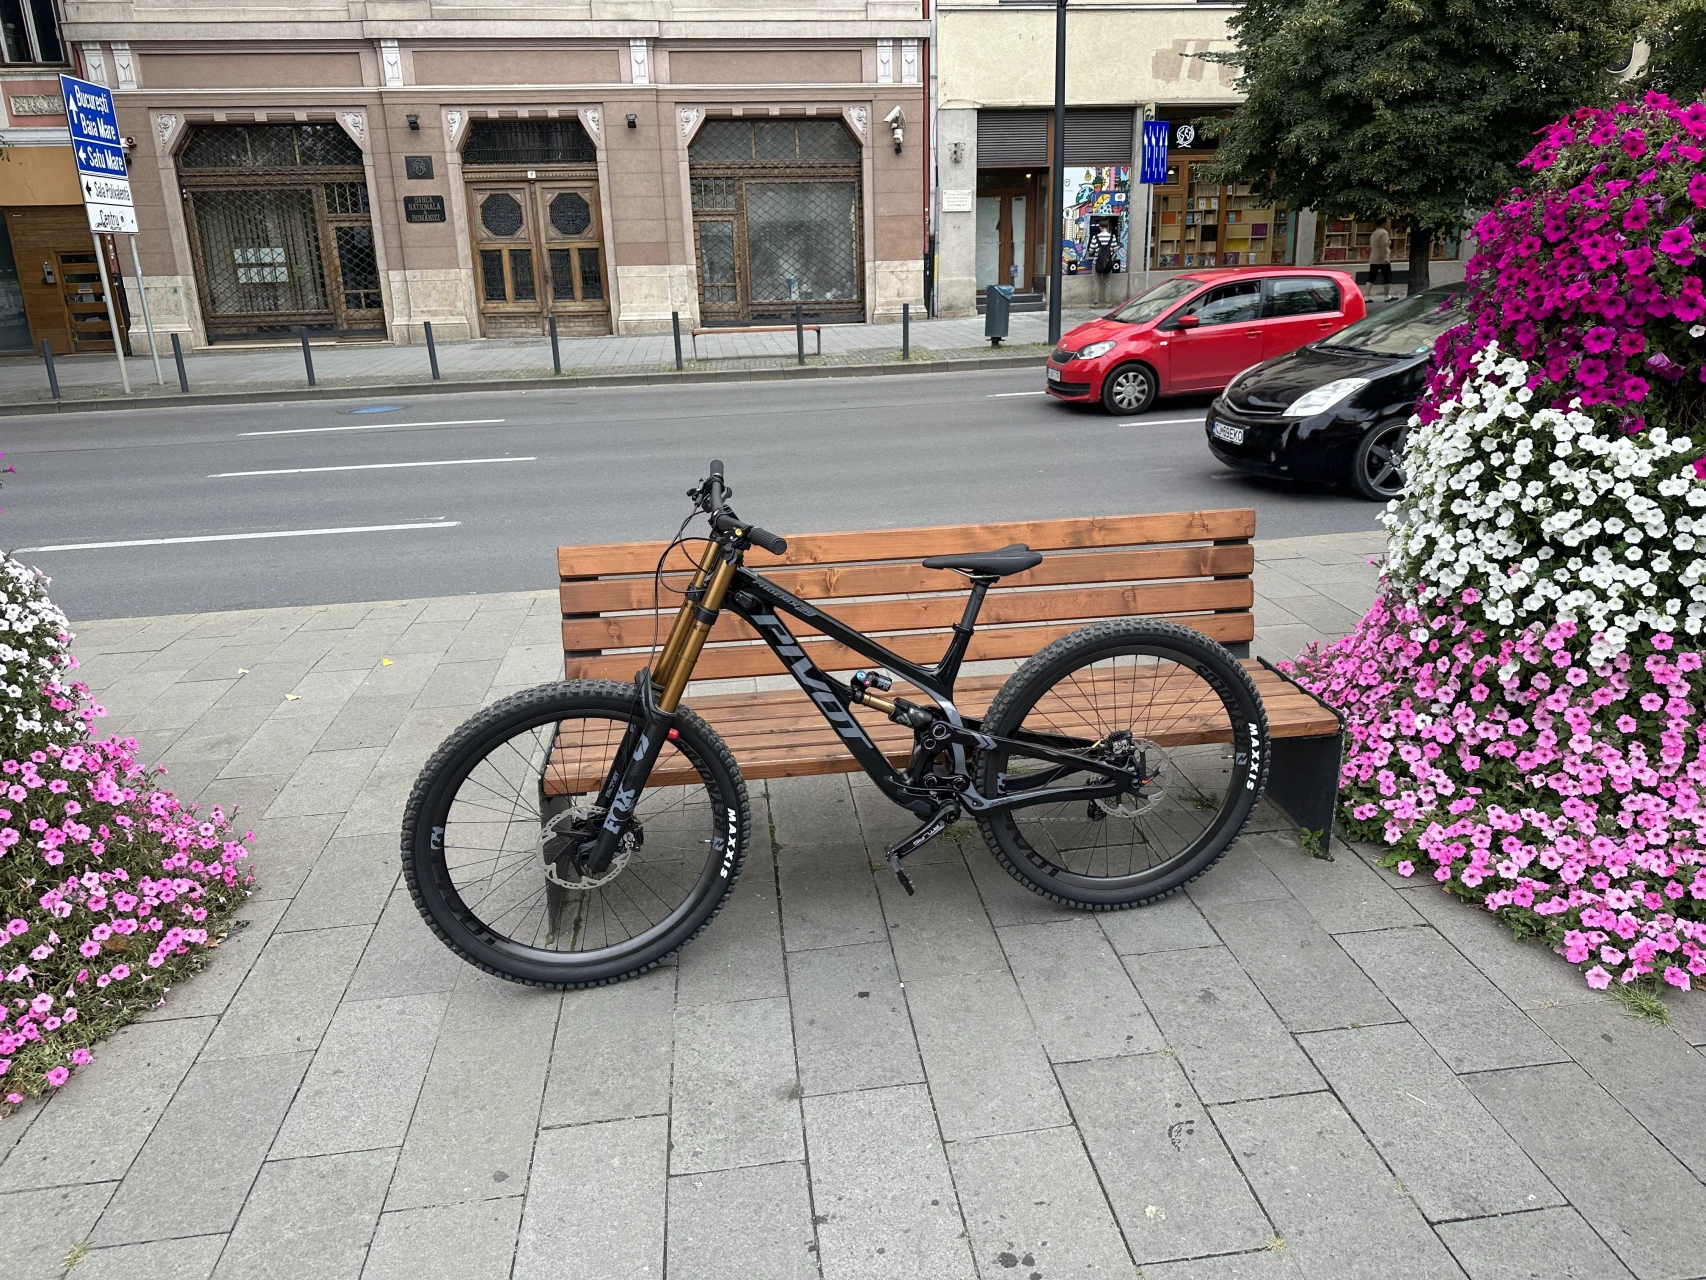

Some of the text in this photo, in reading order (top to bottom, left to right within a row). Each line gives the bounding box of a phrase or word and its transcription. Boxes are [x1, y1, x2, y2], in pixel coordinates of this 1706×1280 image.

[80, 112, 116, 140] Baia Mare
[87, 146, 124, 171] Satu Mare
[94, 181, 106, 198] Sala
[751, 614, 874, 749] PIVOT
[1246, 722, 1260, 791] MAXXIS
[603, 782, 638, 835] FOX
[719, 807, 737, 879] MAXXIS
